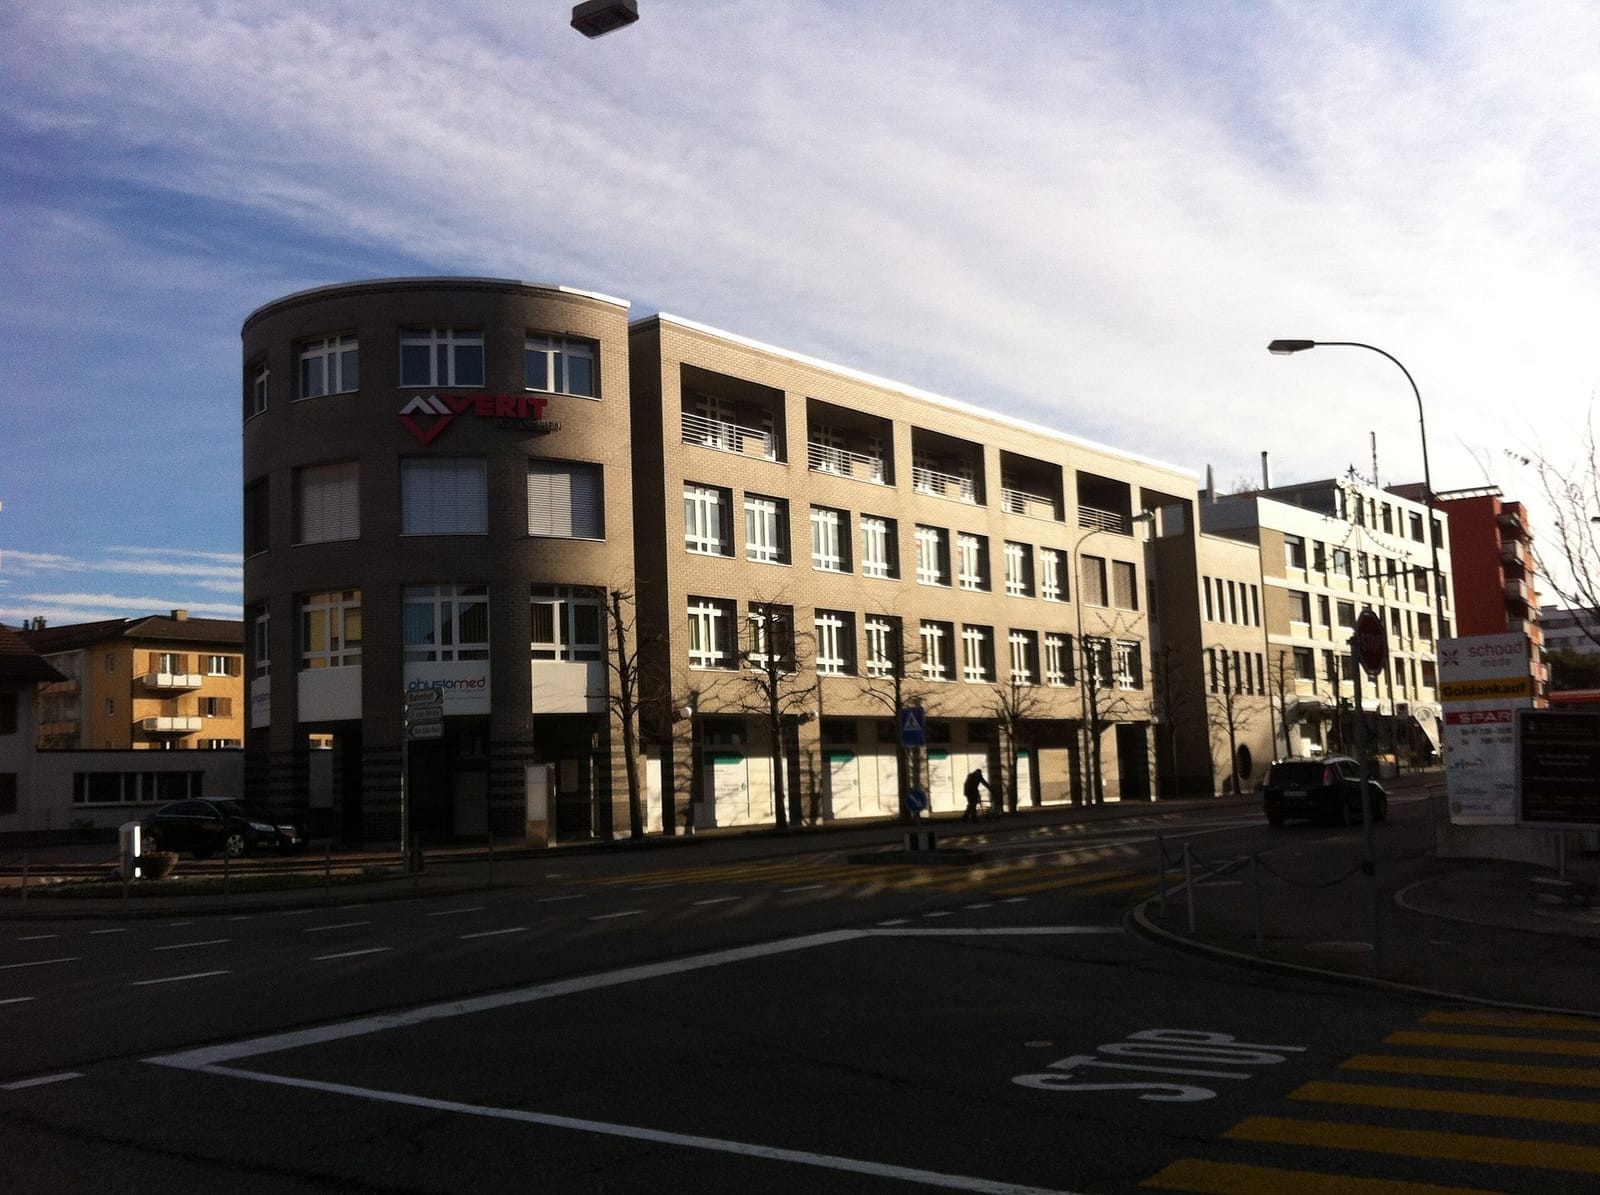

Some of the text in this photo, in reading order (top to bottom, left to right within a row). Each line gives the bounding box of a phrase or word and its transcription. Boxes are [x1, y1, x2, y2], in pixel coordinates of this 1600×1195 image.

[438, 393, 548, 420] VERIT
[1443, 681, 1526, 698] Goldankauf
[1459, 711, 1512, 724] SPAR
[1011, 1028, 1308, 1103] STOP
